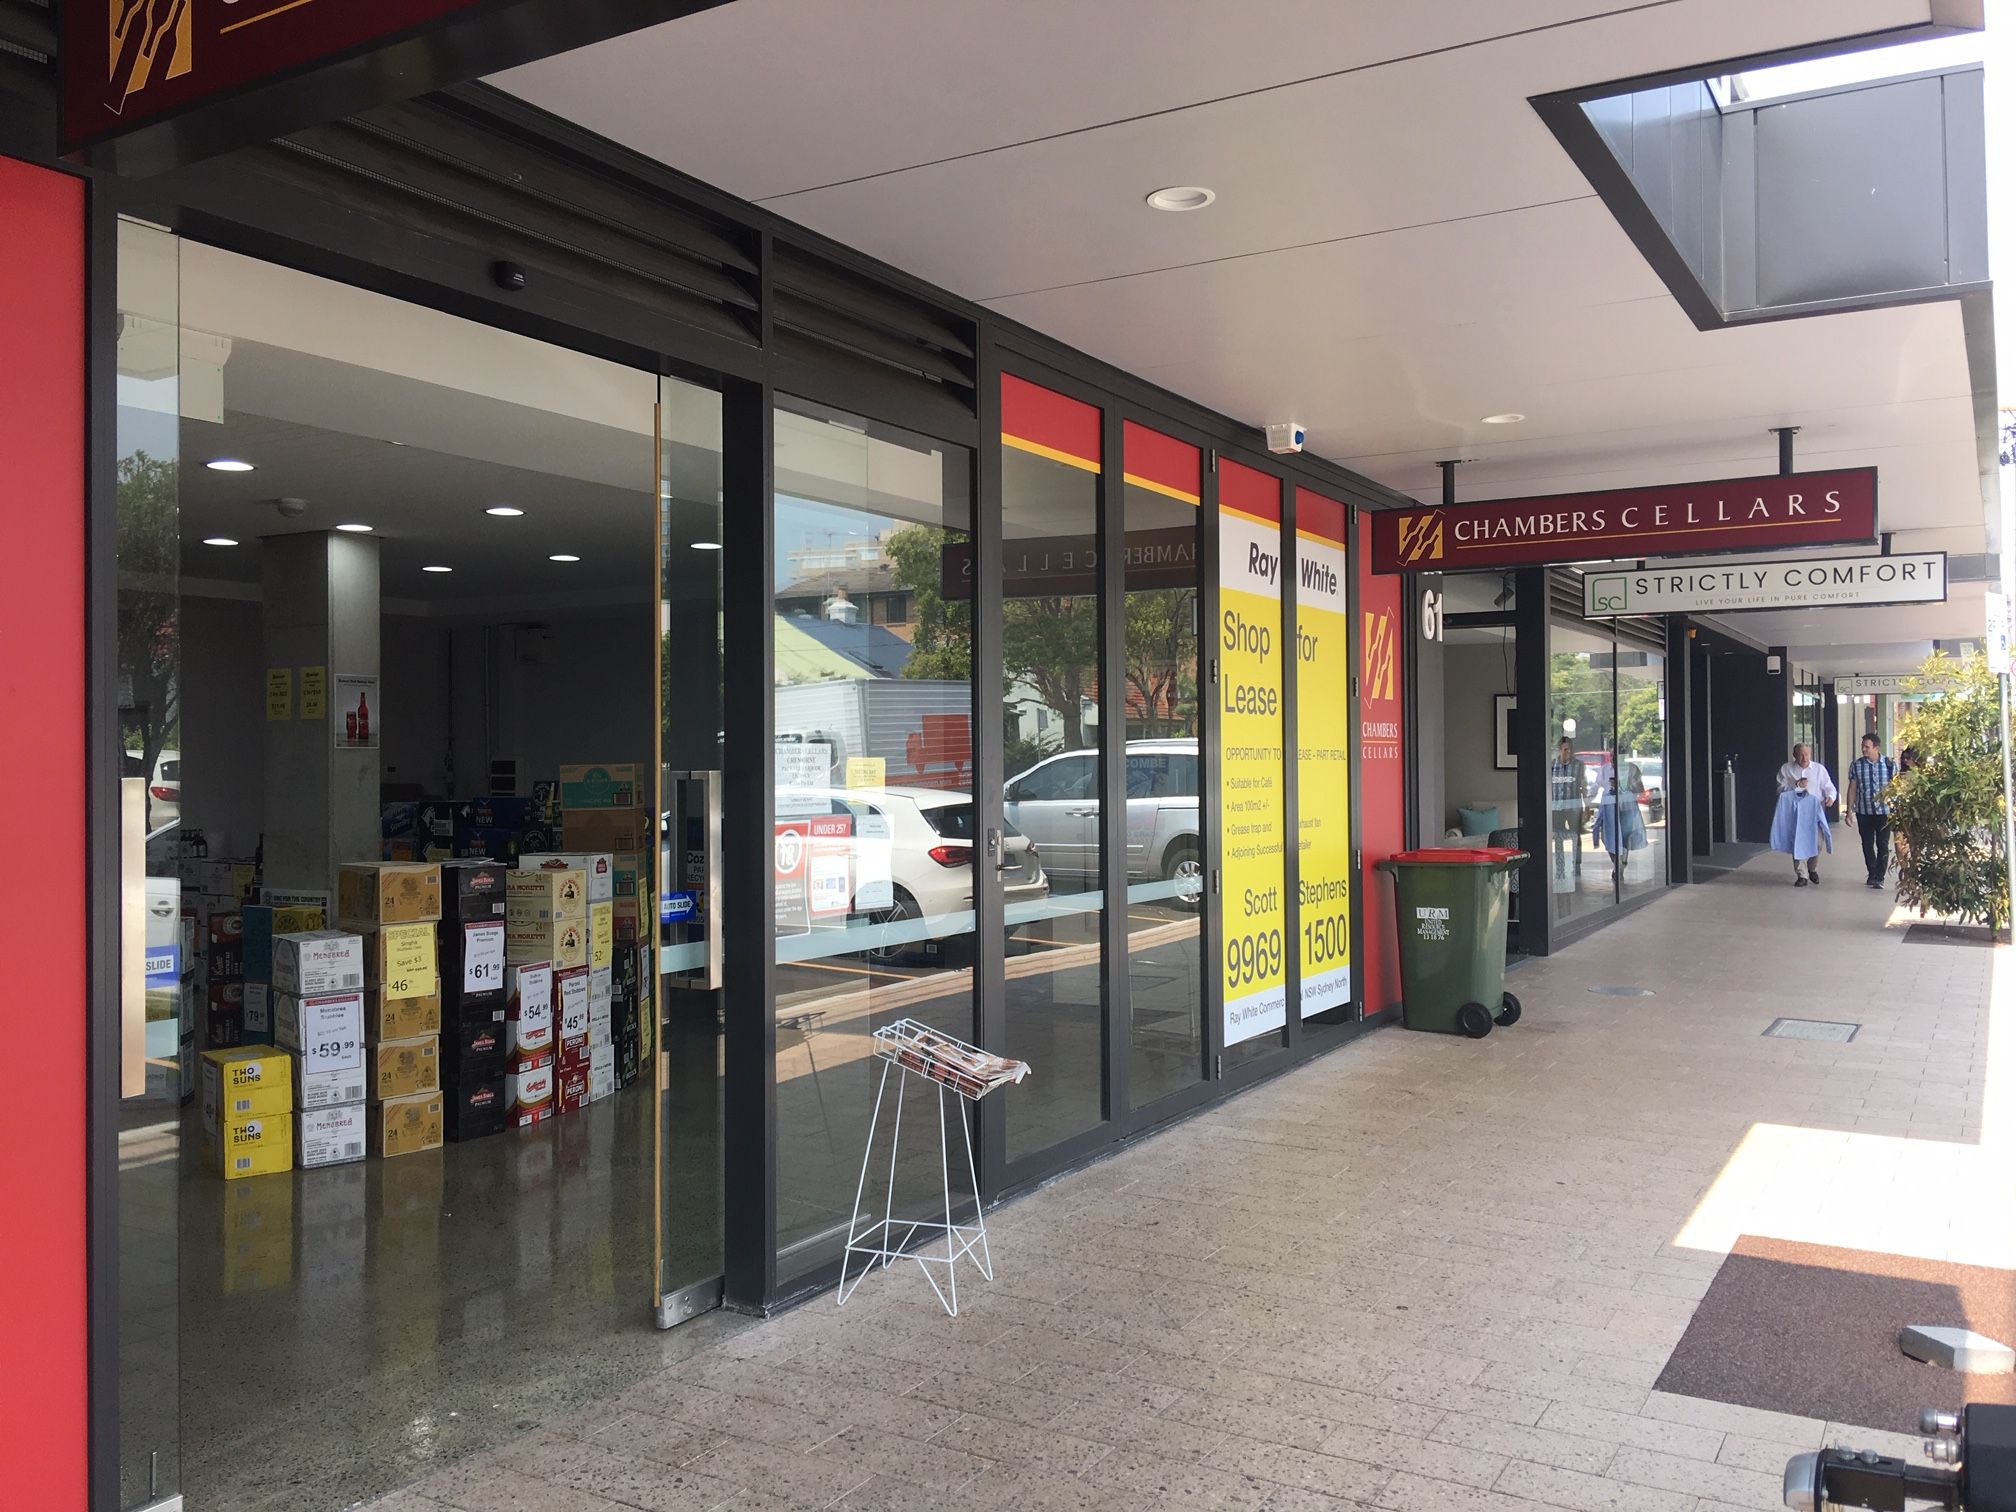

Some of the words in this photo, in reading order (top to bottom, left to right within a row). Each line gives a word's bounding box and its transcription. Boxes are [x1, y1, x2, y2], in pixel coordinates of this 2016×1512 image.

[1455, 509, 1606, 541] CHAMBERS
[1621, 491, 1840, 528] CELLARS
[1248, 541, 1279, 586] Ray
[1301, 557, 1337, 595] White
[1635, 571, 1768, 595] STRICTLY
[1784, 562, 1936, 587] COMFORT
[1598, 597, 1622, 610] SC
[1719, 597, 1744, 605] YOUR
[1747, 596, 1767, 604] LIFE
[1812, 591, 1860, 600] COMFORT
[1422, 589, 1443, 642] 61
[1223, 609, 1271, 664] Shop
[1296, 624, 1318, 662] for
[1224, 673, 1278, 717] Lease
[1362, 721, 1398, 738] CHAMBERS
[1226, 747, 1272, 760] OPPORTUNITY
[1273, 747, 1282, 760] TO
[1298, 749, 1312, 760] EASE
[1316, 750, 1330, 760] PART
[1330, 749, 1347, 761] RETAIL
[1362, 746, 1399, 759] CELLARS
[1231, 777, 1252, 789] Suitable
[1230, 802, 1244, 813] Area
[1244, 800, 1261, 812] 100m2
[475, 816, 493, 825] NEW
[814, 824, 836, 835] UNDER
[1231, 823, 1251, 836] Grease
[1231, 846, 1256, 861] Adjoining
[384, 896, 395, 905] 24
[1244, 886, 1278, 917] Scott
[1299, 877, 1347, 909] Stephens
[1418, 908, 1448, 919] URM
[1227, 928, 1281, 989] 9969
[1304, 914, 1347, 965] 1500
[145, 959, 171, 971] SLIDE
[397, 957, 413, 968] Save
[1229, 1010, 1241, 1026] Ray
[1241, 1004, 1259, 1021] White
[1316, 980, 1334, 998] Sydney
[1334, 976, 1347, 990] North
[385, 1013, 396, 1023] 24
[566, 1035, 584, 1047] PERONI
[232, 1067, 255, 1076] TWO
[381, 1072, 392, 1081] 24
[232, 1075, 261, 1085] SUNS
[567, 1083, 584, 1095] PERONI
[232, 1125, 255, 1134] TWO
[387, 1129, 398, 1138] 24
[233, 1133, 262, 1143] SUNS
